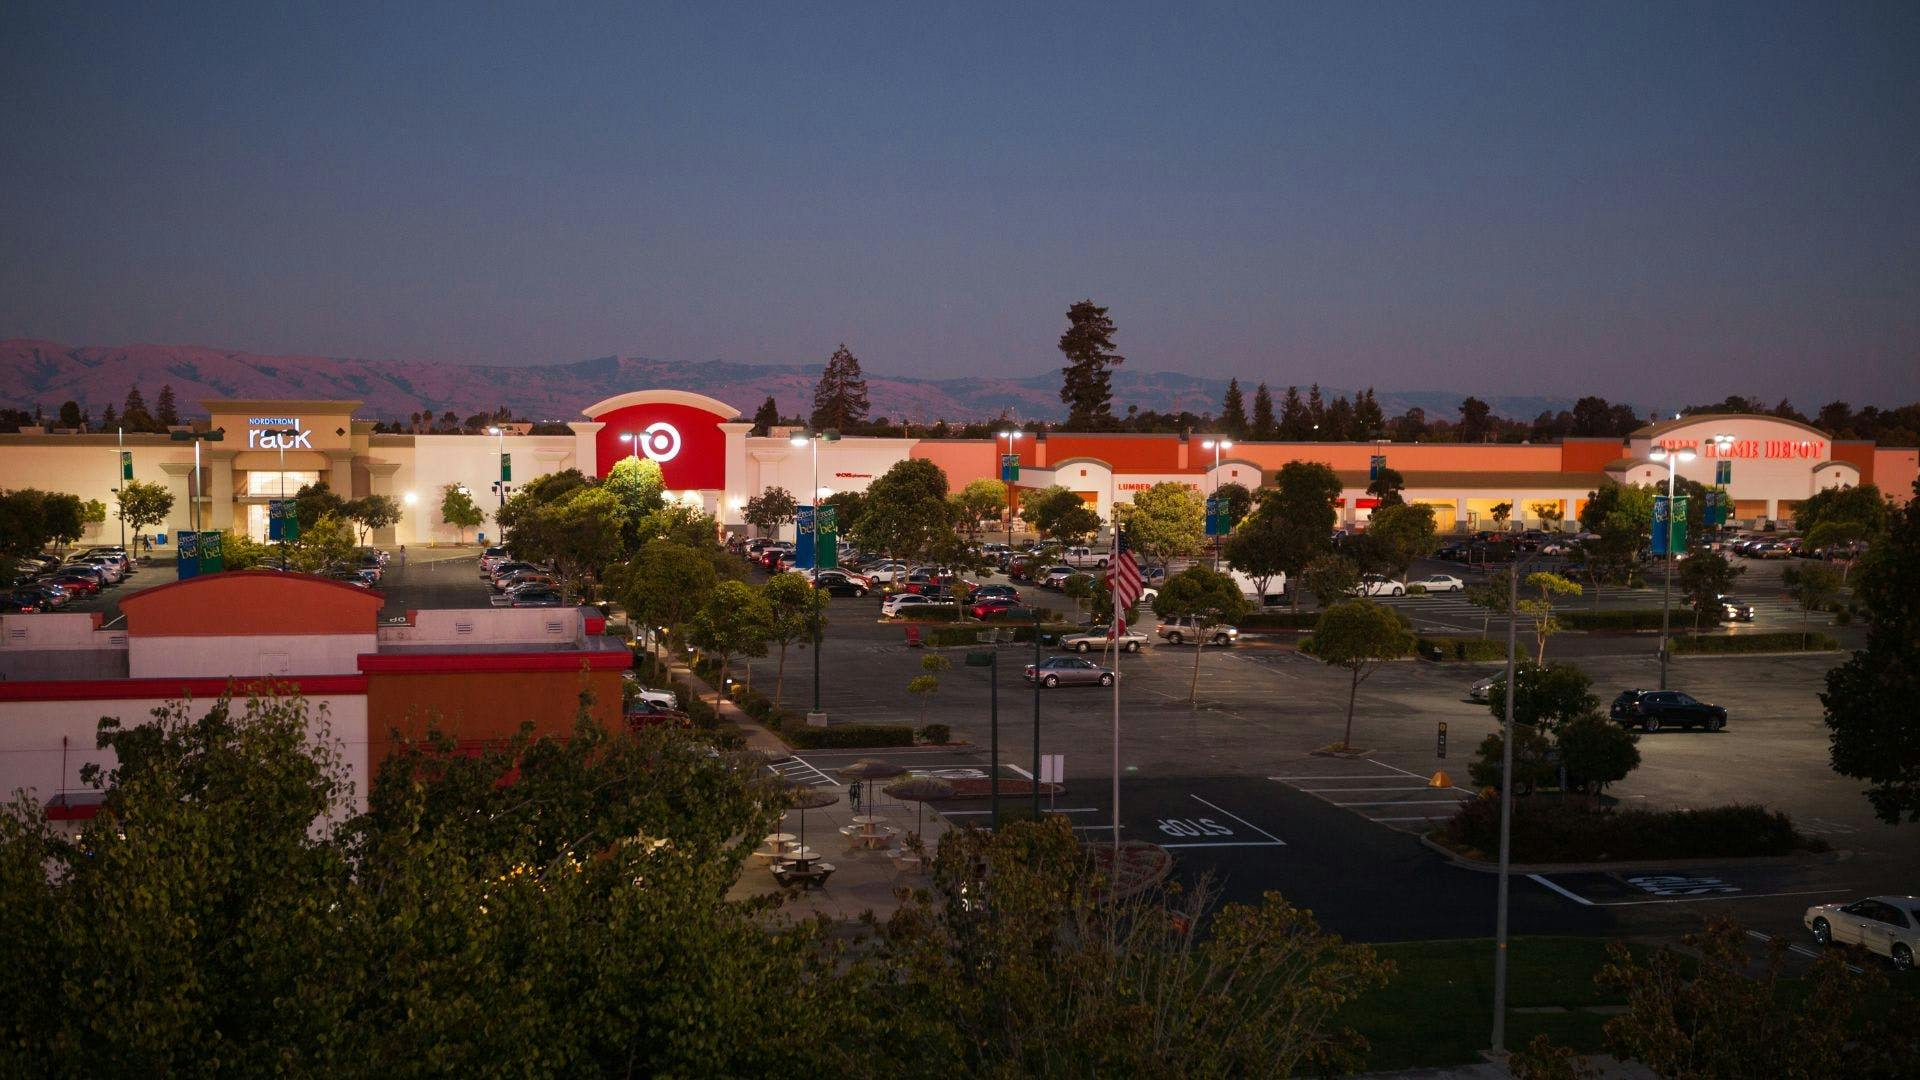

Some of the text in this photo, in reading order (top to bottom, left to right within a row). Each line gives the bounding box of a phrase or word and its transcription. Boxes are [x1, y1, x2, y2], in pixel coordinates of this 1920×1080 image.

[249, 418, 312, 449] rack
[1764, 440, 1825, 459] DEPOT
[1118, 483, 1151, 491] LUMBER
[1157, 818, 1235, 837] STOP
